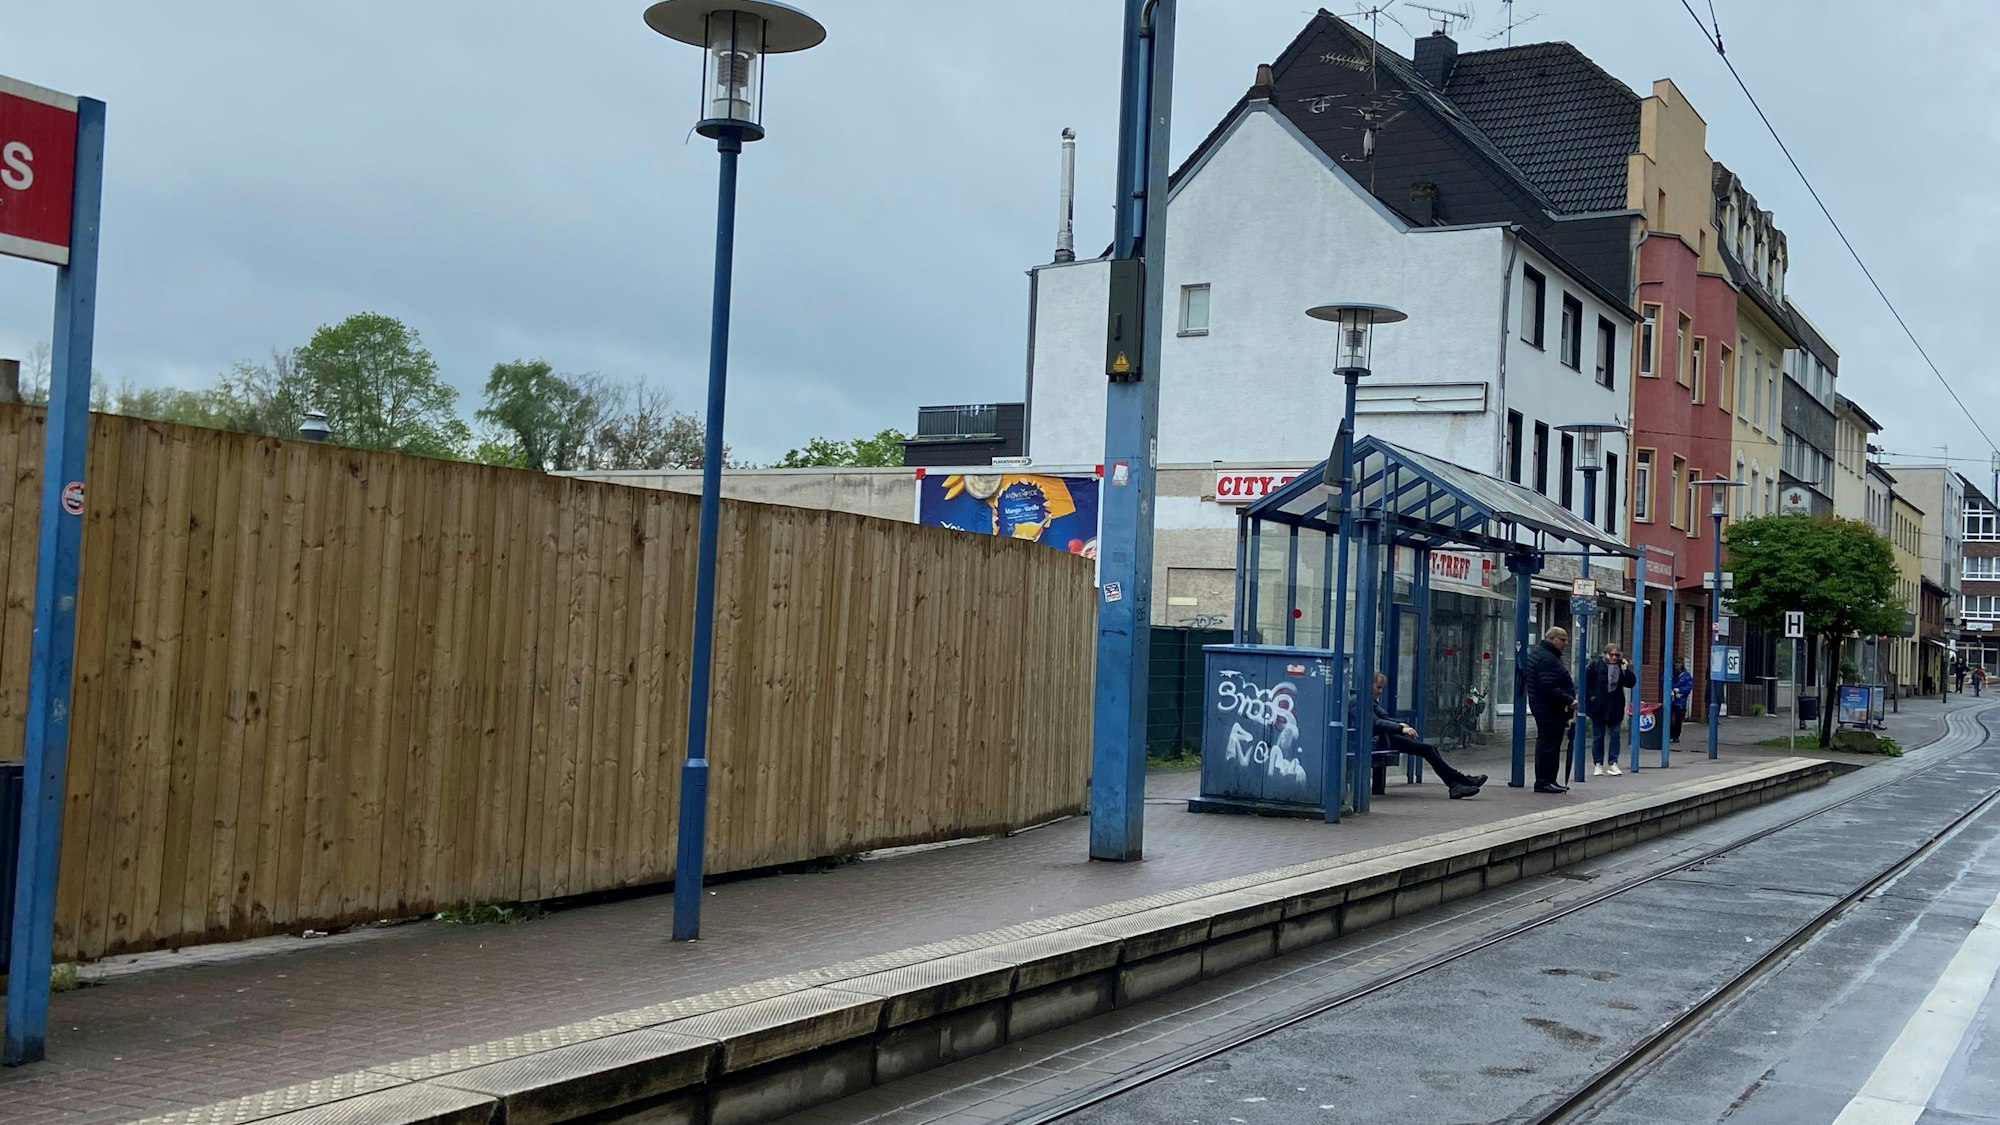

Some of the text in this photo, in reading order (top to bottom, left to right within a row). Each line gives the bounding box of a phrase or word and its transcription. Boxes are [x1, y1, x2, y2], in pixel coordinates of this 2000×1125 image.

[0, 141, 34, 190] S
[1429, 552, 1471, 580] Y-TREFF
[1788, 614, 1801, 634] H
